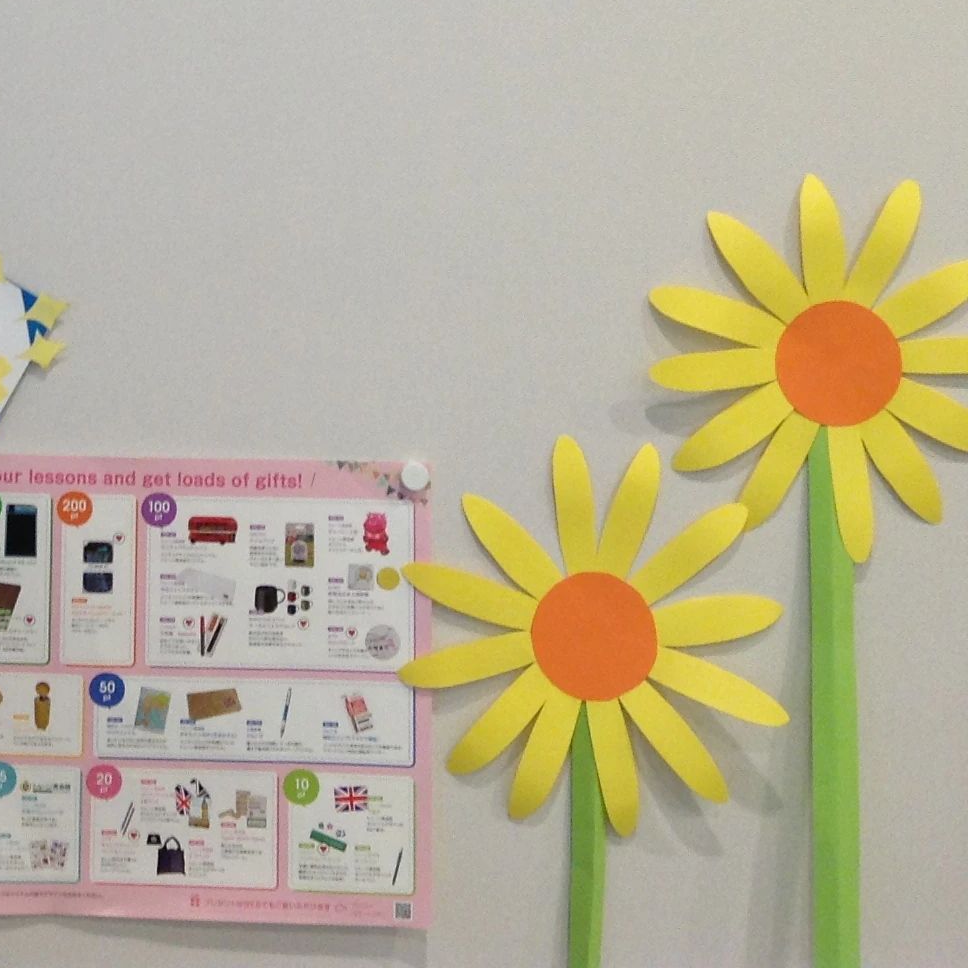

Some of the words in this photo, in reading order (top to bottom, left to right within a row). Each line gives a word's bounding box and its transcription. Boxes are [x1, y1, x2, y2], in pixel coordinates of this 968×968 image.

[29, 469, 97, 486] lessons
[105, 471, 137, 486] and
[143, 474, 171, 489] get
[178, 472, 225, 487] loads
[232, 473, 250, 488] of
[256, 474, 303, 490] gifts!
[62, 500, 87, 512] 200
[149, 501, 170, 514] 100
[99, 681, 116, 694] 50
[96, 774, 113, 786] 20
[294, 778, 310, 791] 10
